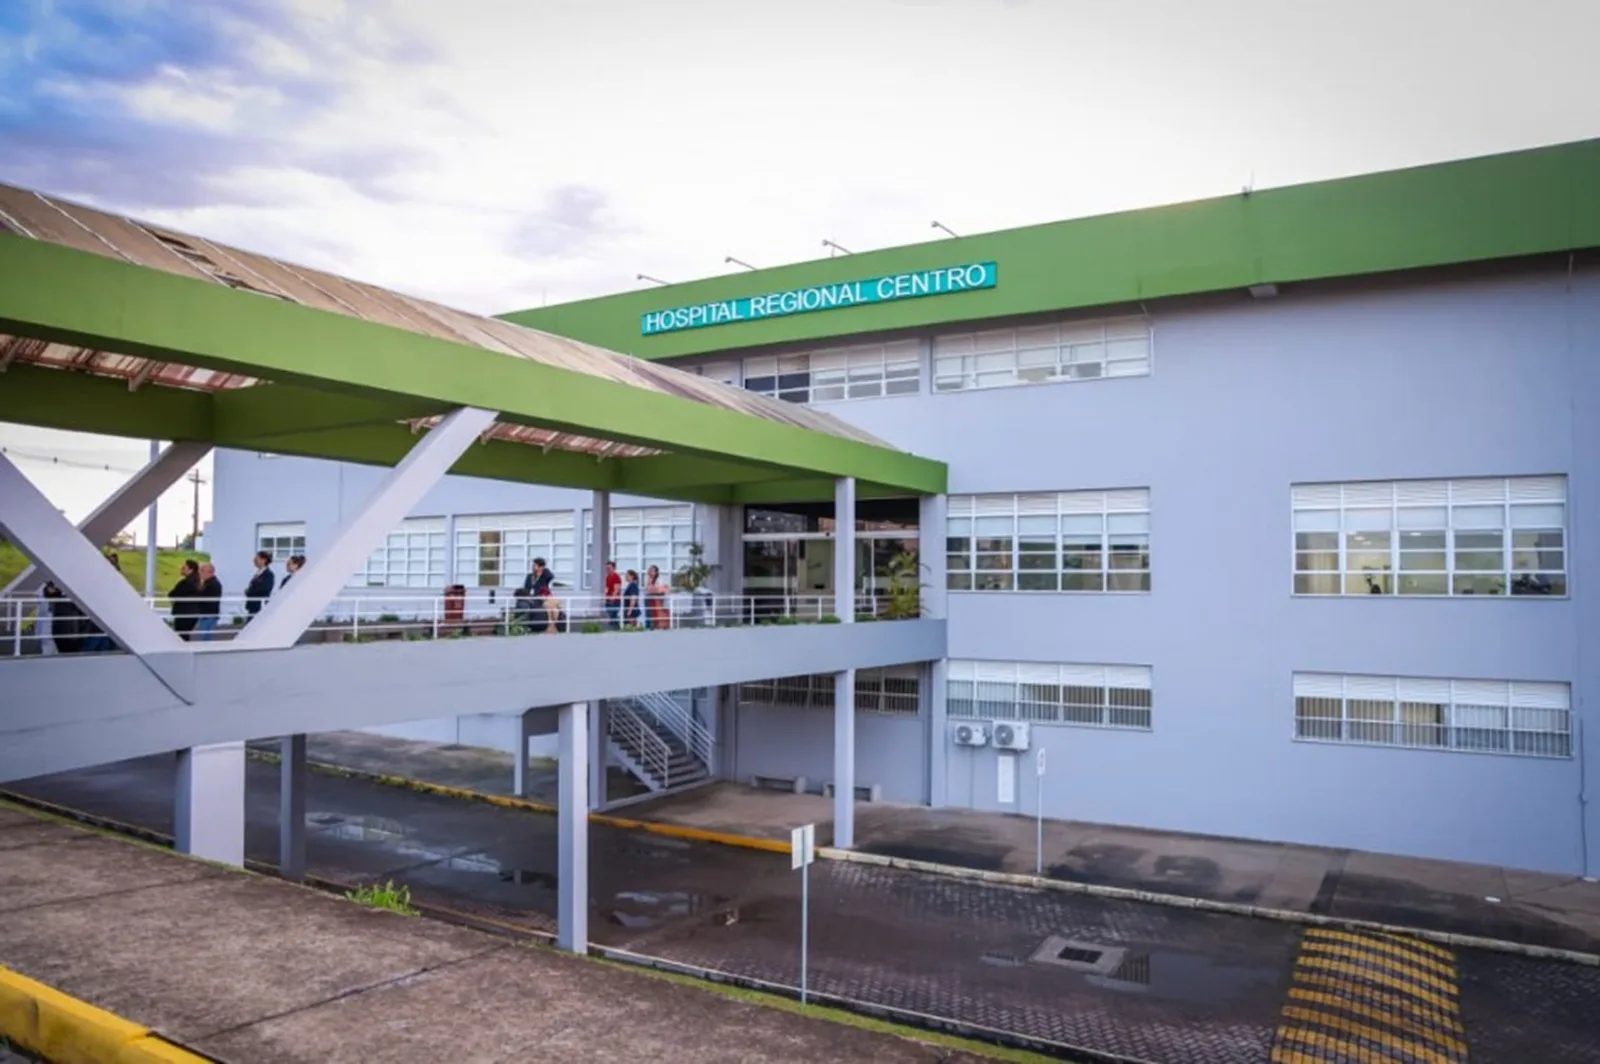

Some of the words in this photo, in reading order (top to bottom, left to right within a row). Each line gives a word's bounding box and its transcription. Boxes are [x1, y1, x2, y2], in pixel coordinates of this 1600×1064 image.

[646, 300, 743, 331] HOSPITAL
[750, 281, 867, 317] REGIONAL
[877, 264, 986, 299] CENTRO
